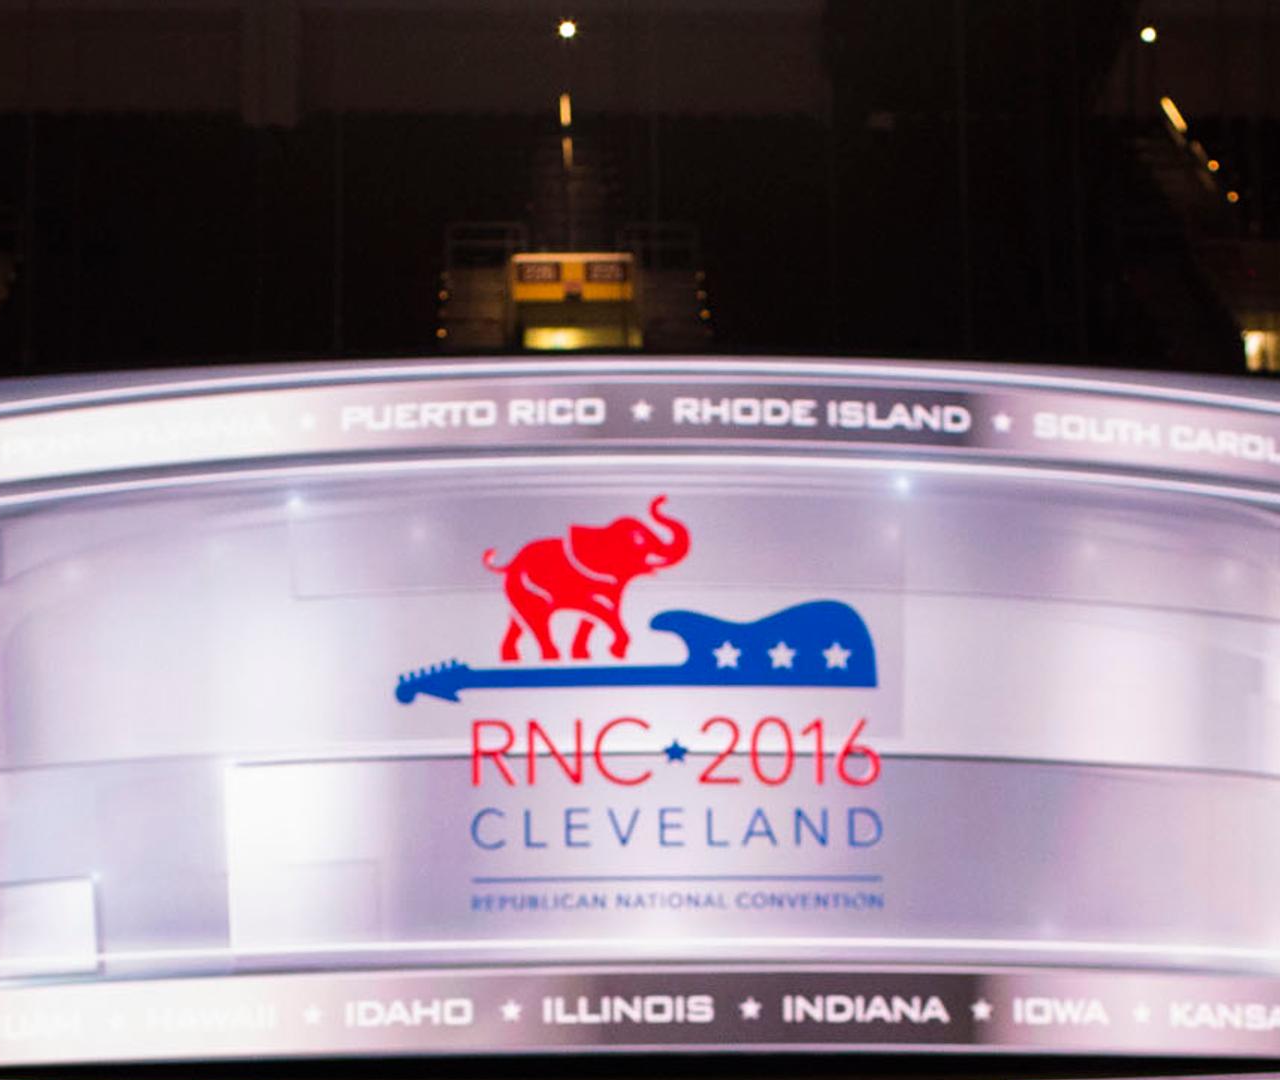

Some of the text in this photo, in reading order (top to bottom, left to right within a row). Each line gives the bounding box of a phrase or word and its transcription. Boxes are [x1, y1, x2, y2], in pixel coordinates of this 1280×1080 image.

[341, 399, 498, 431] PUERTO
[507, 397, 606, 427] RICO
[673, 397, 818, 427] RHODE
[827, 400, 972, 434] ISLAND
[1032, 411, 1161, 447] SOUTH
[470, 716, 881, 787] RNC 2016
[469, 806, 884, 850] CLEVELAND
[470, 893, 885, 912] REPUBLICAN NATIONAL CONVENTION
[344, 998, 473, 1027] IDAHO
[542, 995, 715, 1024] ILLINOIS
[782, 995, 952, 1024] INDIANA
[1012, 997, 1110, 1025] IOWA
